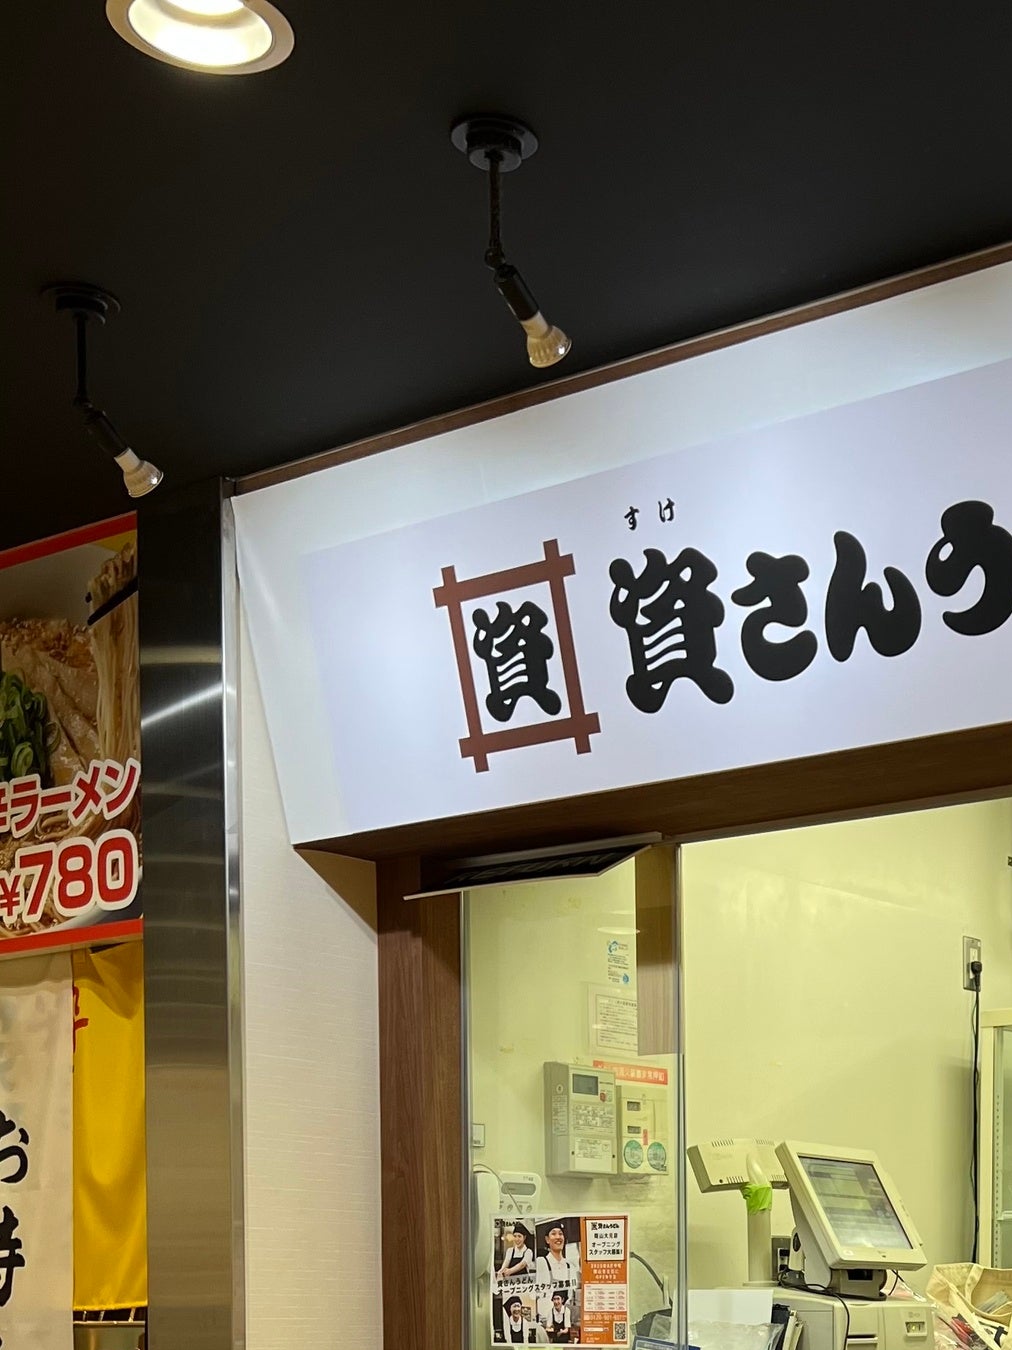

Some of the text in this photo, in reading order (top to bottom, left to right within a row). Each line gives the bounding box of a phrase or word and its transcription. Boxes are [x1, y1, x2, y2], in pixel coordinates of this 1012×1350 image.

[624, 496, 677, 532] すけ
[472, 600, 562, 722] 資
[0, 836, 136, 918] ¥780
